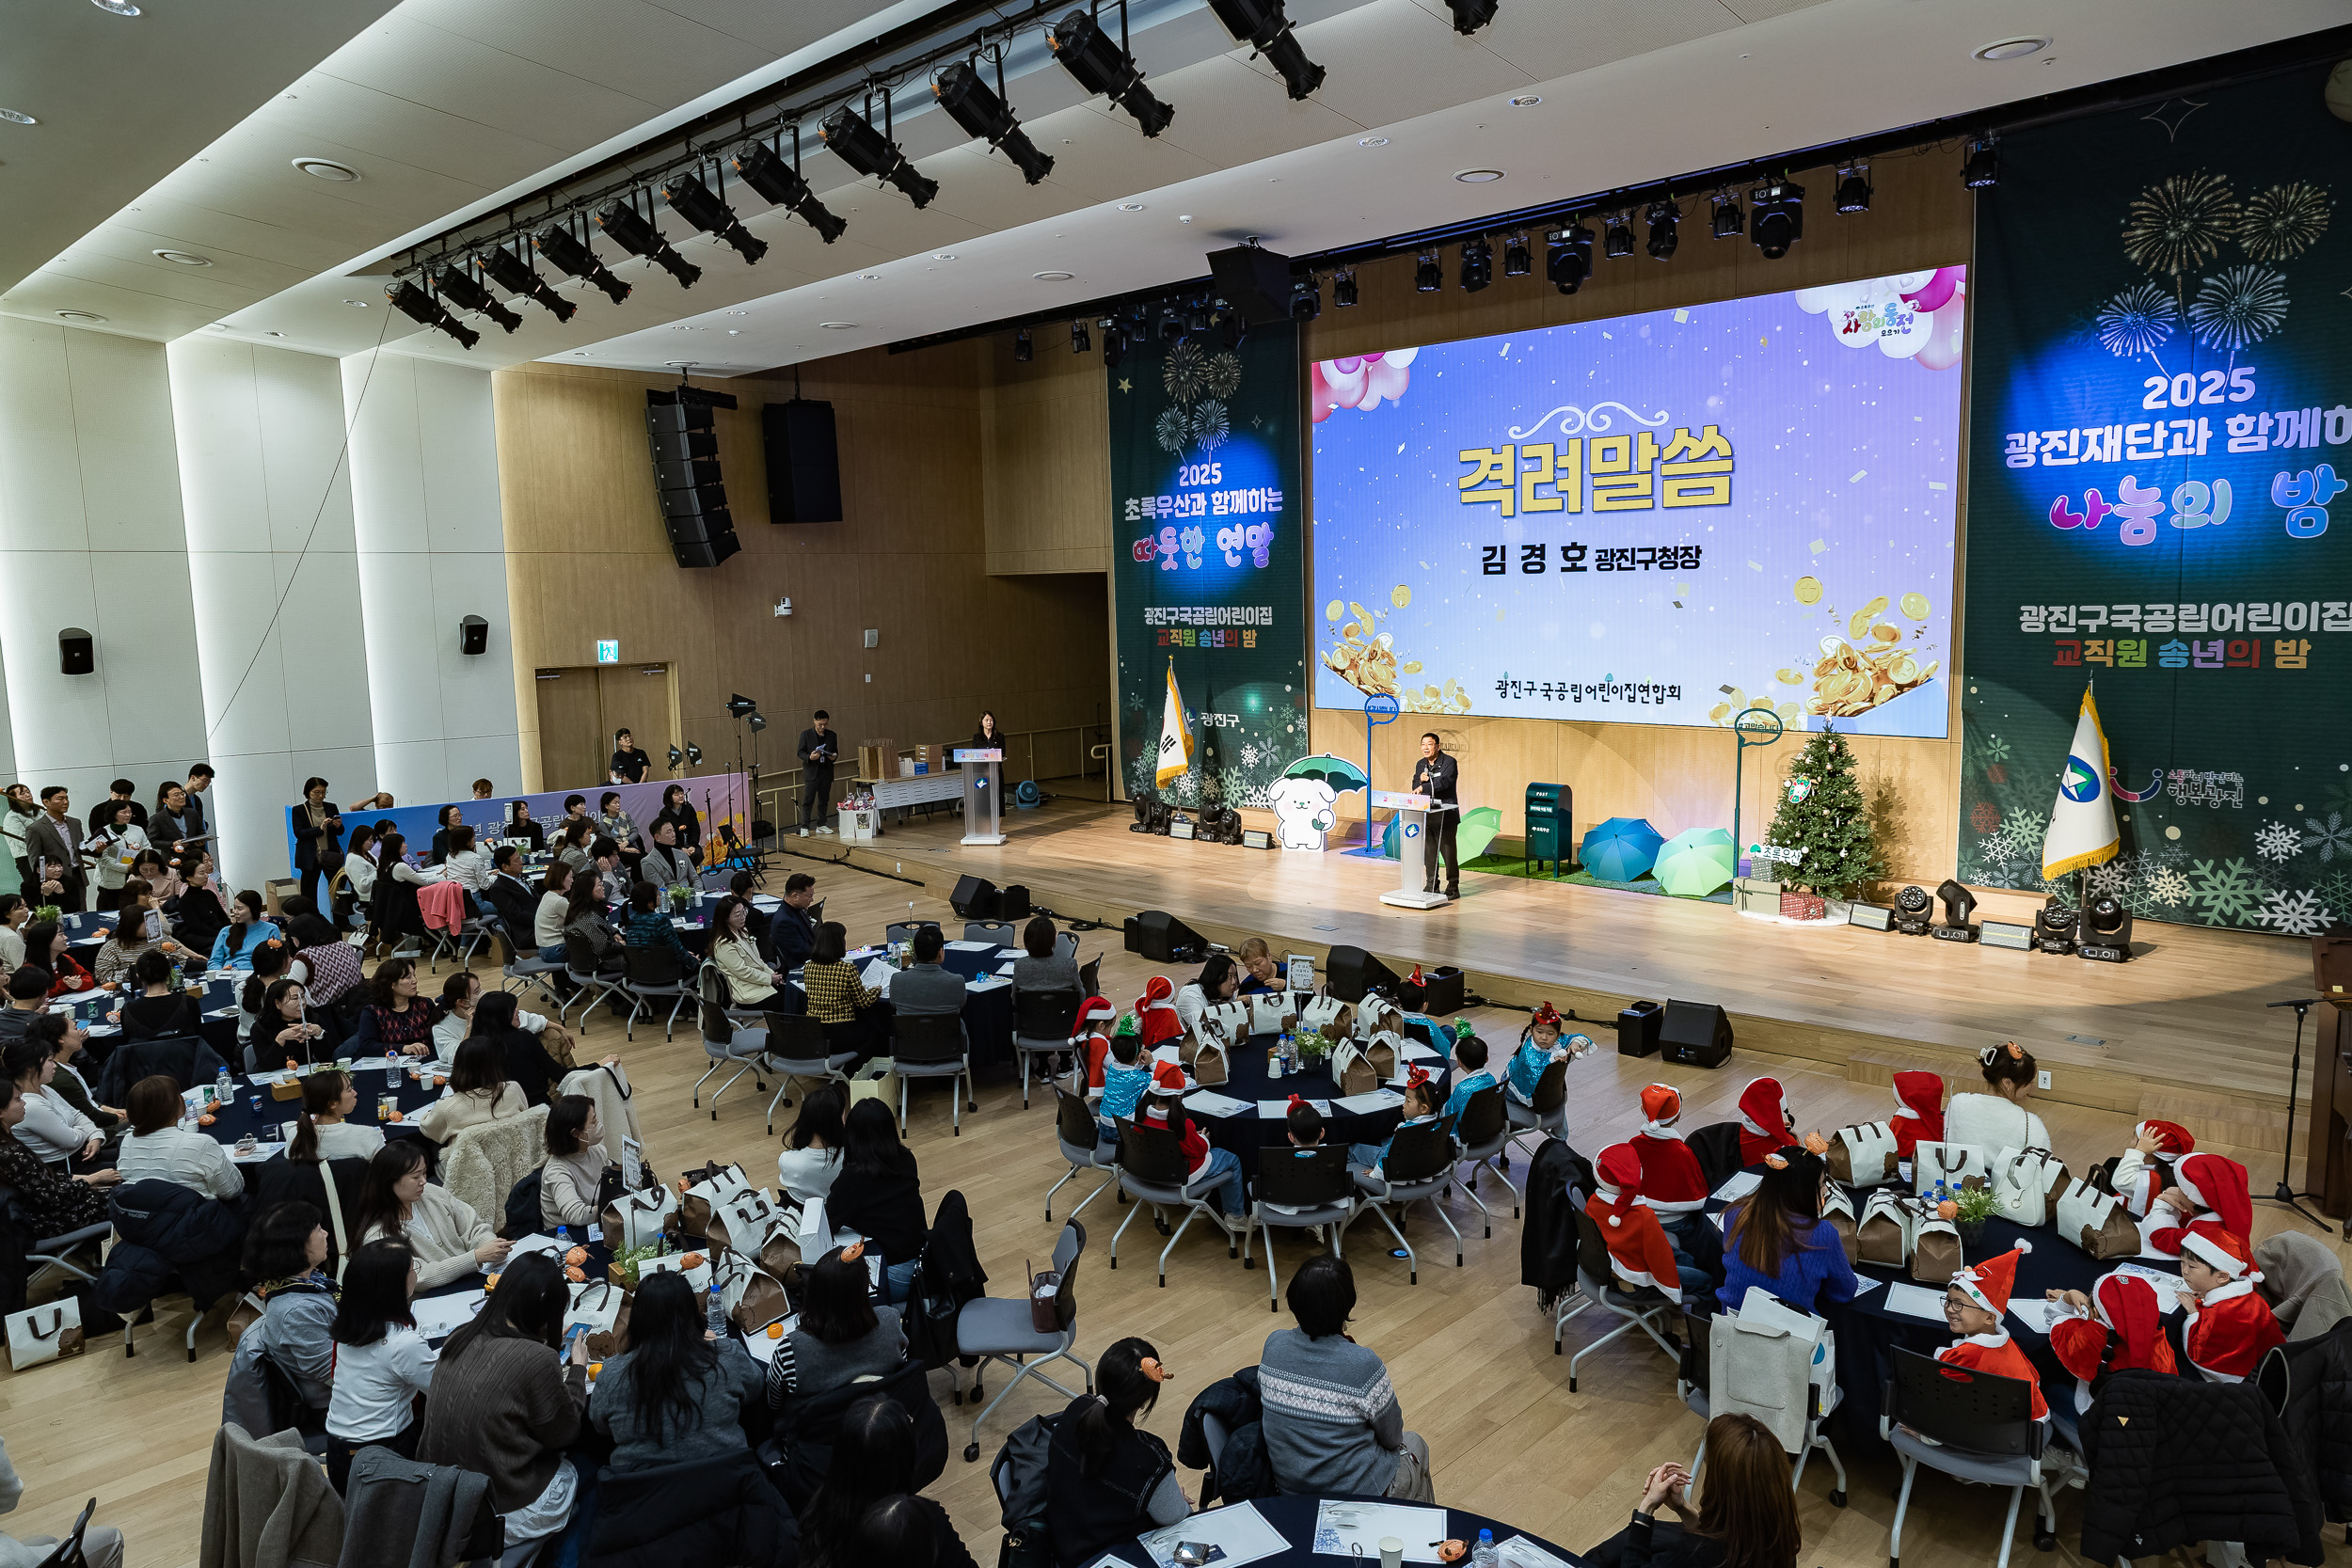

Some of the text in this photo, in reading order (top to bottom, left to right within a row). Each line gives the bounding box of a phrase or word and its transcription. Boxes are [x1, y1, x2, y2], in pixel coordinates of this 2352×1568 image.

[1843, 303, 1914, 334] 사랑의 동전
[2142, 366, 2256, 410] 2025
[2004, 417, 2214, 468] 광진재단과
[1179, 462, 1223, 487] 2025
[1457, 424, 1736, 518] 격려말씀
[1124, 486, 1283, 522] 초록우산과 함께하는
[2049, 475, 2233, 546] 나눔의
[1133, 522, 1275, 571] 따뜻한 연말
[1482, 542, 1702, 576] 김 경 호 광진구청장
[1144, 606, 1273, 626] 광진구국공립어린이집
[2019, 602, 2352, 633] 광진구국공립어린이집
[1156, 628, 1257, 648] 교직원 송년의 밤
[2053, 638, 2312, 669] 교직원 송년의 밤
[1495, 679, 1537, 701] 광진구
[1200, 711, 1240, 728] 광진구
[2168, 768, 2244, 786] 소통하며 발전하는
[2167, 782, 2244, 809] 행복광진
[1762, 846, 1802, 865] 초록우산
